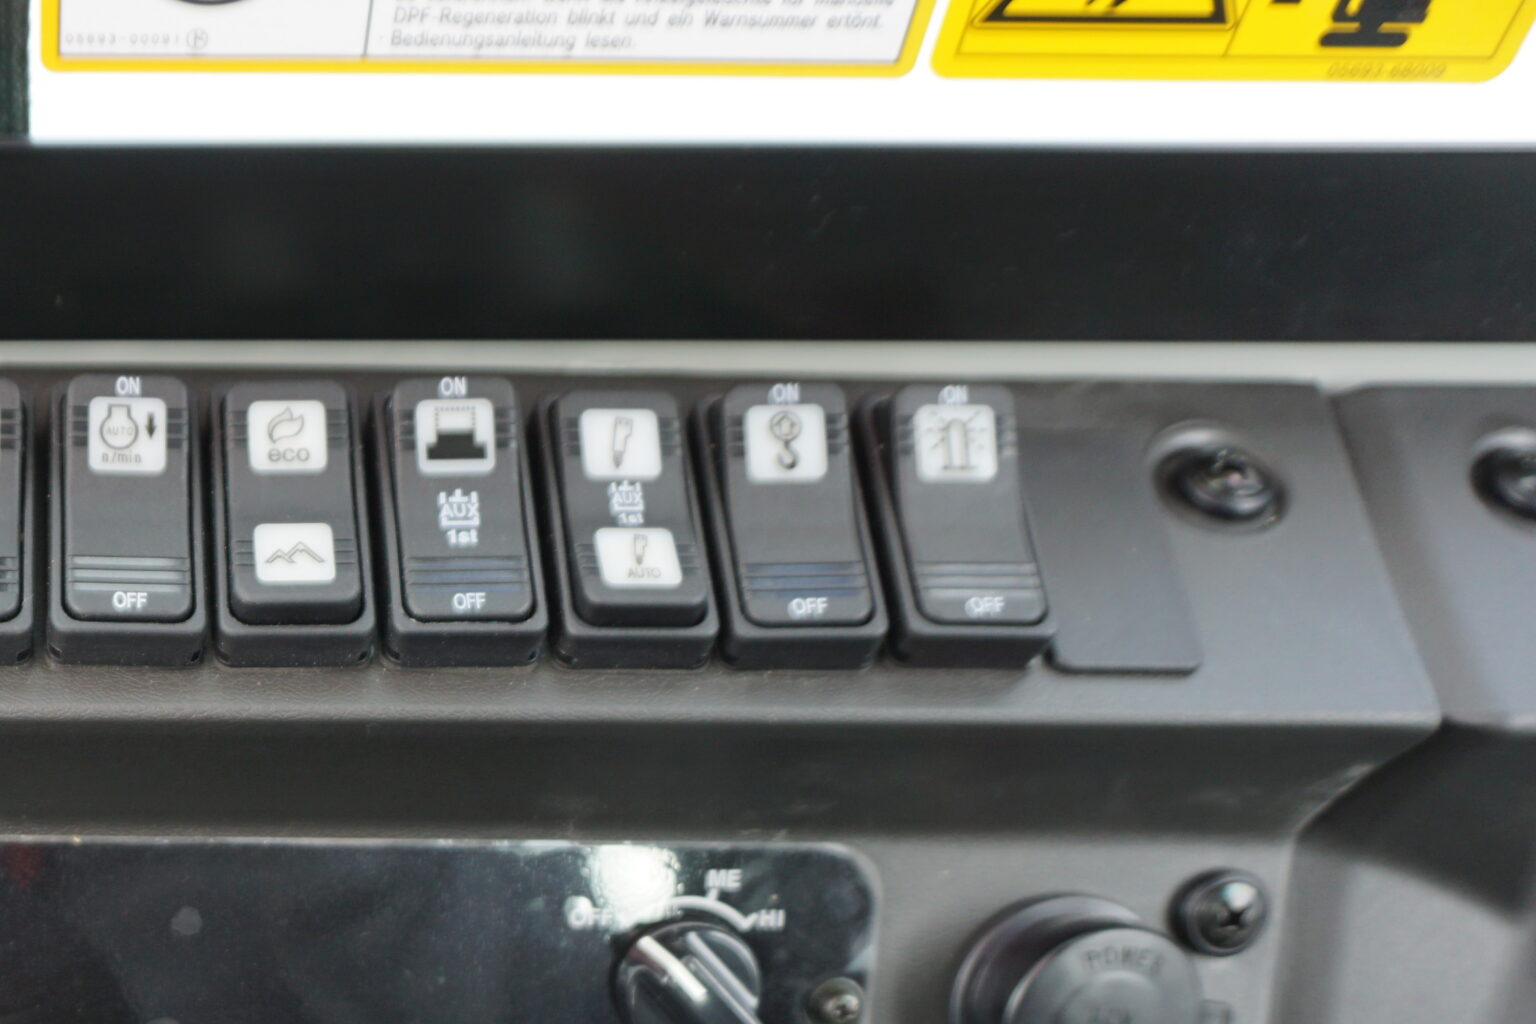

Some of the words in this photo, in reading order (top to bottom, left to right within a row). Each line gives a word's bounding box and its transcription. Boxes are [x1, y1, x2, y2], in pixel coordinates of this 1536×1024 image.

[567, 6, 615, 26] blinkt
[624, 10, 659, 26] und
[667, 10, 692, 27] ein
[704, 10, 817, 30] Warnsummer
[390, 29, 576, 52] Bedienungsanleitung
[115, 376, 140, 395] ON
[440, 376, 466, 396] ON
[770, 384, 800, 402] ON
[943, 385, 968, 403] ON
[106, 425, 133, 436] AUTO
[609, 491, 642, 504] AUX
[440, 504, 479, 517] AUX
[617, 512, 643, 523] 1st
[447, 529, 478, 544] 1st
[628, 567, 662, 578] AUTO
[113, 591, 147, 609] OFF
[453, 592, 486, 610] OFF
[792, 597, 828, 615] OFF
[968, 596, 1005, 613] OFF
[760, 910, 785, 926] HI
